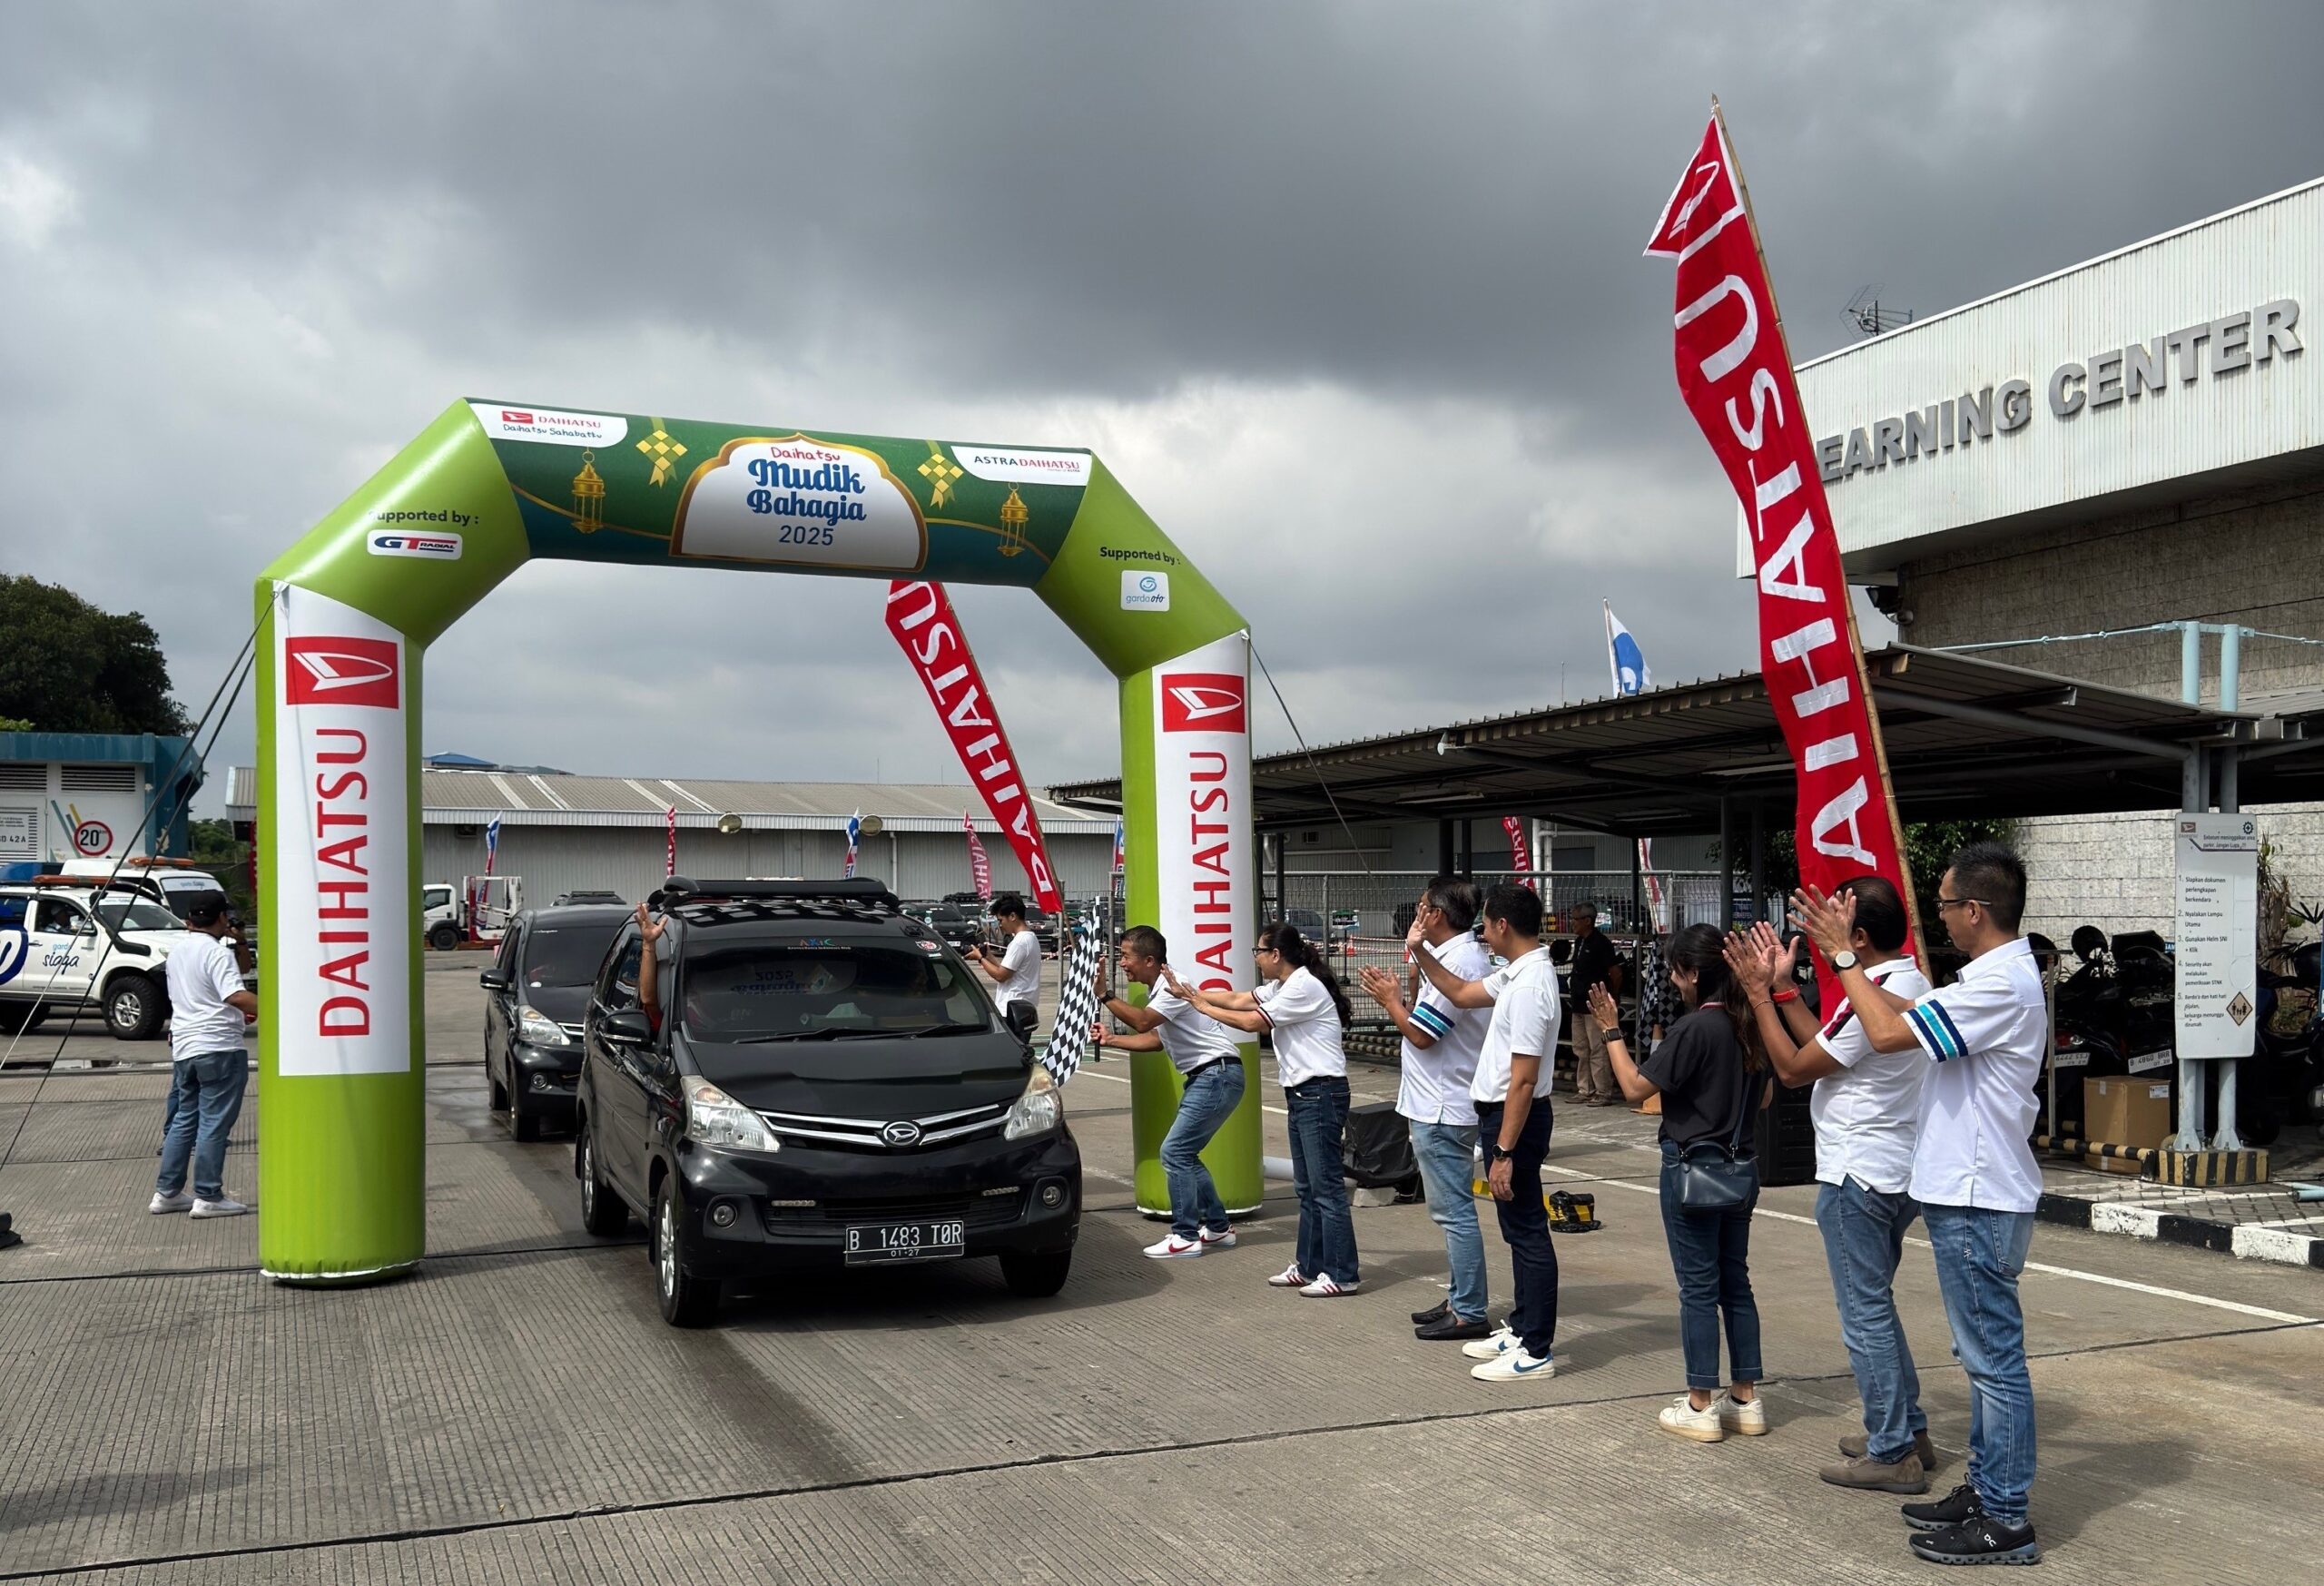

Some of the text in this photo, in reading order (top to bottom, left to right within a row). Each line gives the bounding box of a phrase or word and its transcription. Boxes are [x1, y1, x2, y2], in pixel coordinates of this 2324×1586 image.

[1816, 298, 2303, 482] EARNING CENTER
[503, 424, 547, 433] Daihatsu
[538, 416, 601, 428] DAIHATSU
[771, 447, 841, 461] Daihatsu
[748, 458, 865, 494] Mudik
[746, 488, 867, 526] Bahagia
[369, 510, 448, 523] upported
[452, 510, 470, 527] by
[374, 537, 420, 549] GT
[779, 525, 834, 546] 2025
[1099, 547, 1161, 561] Supported
[1163, 552, 1175, 566] by
[1675, 274, 1876, 869] AIHATSU
[888, 582, 1053, 892] DAIHATSU
[80, 829, 100, 846] 20
[315, 727, 370, 1037] DAIHATSU
[53, 942, 71, 951] gard
[850, 1230, 860, 1250] B
[880, 1226, 920, 1248] 1483
